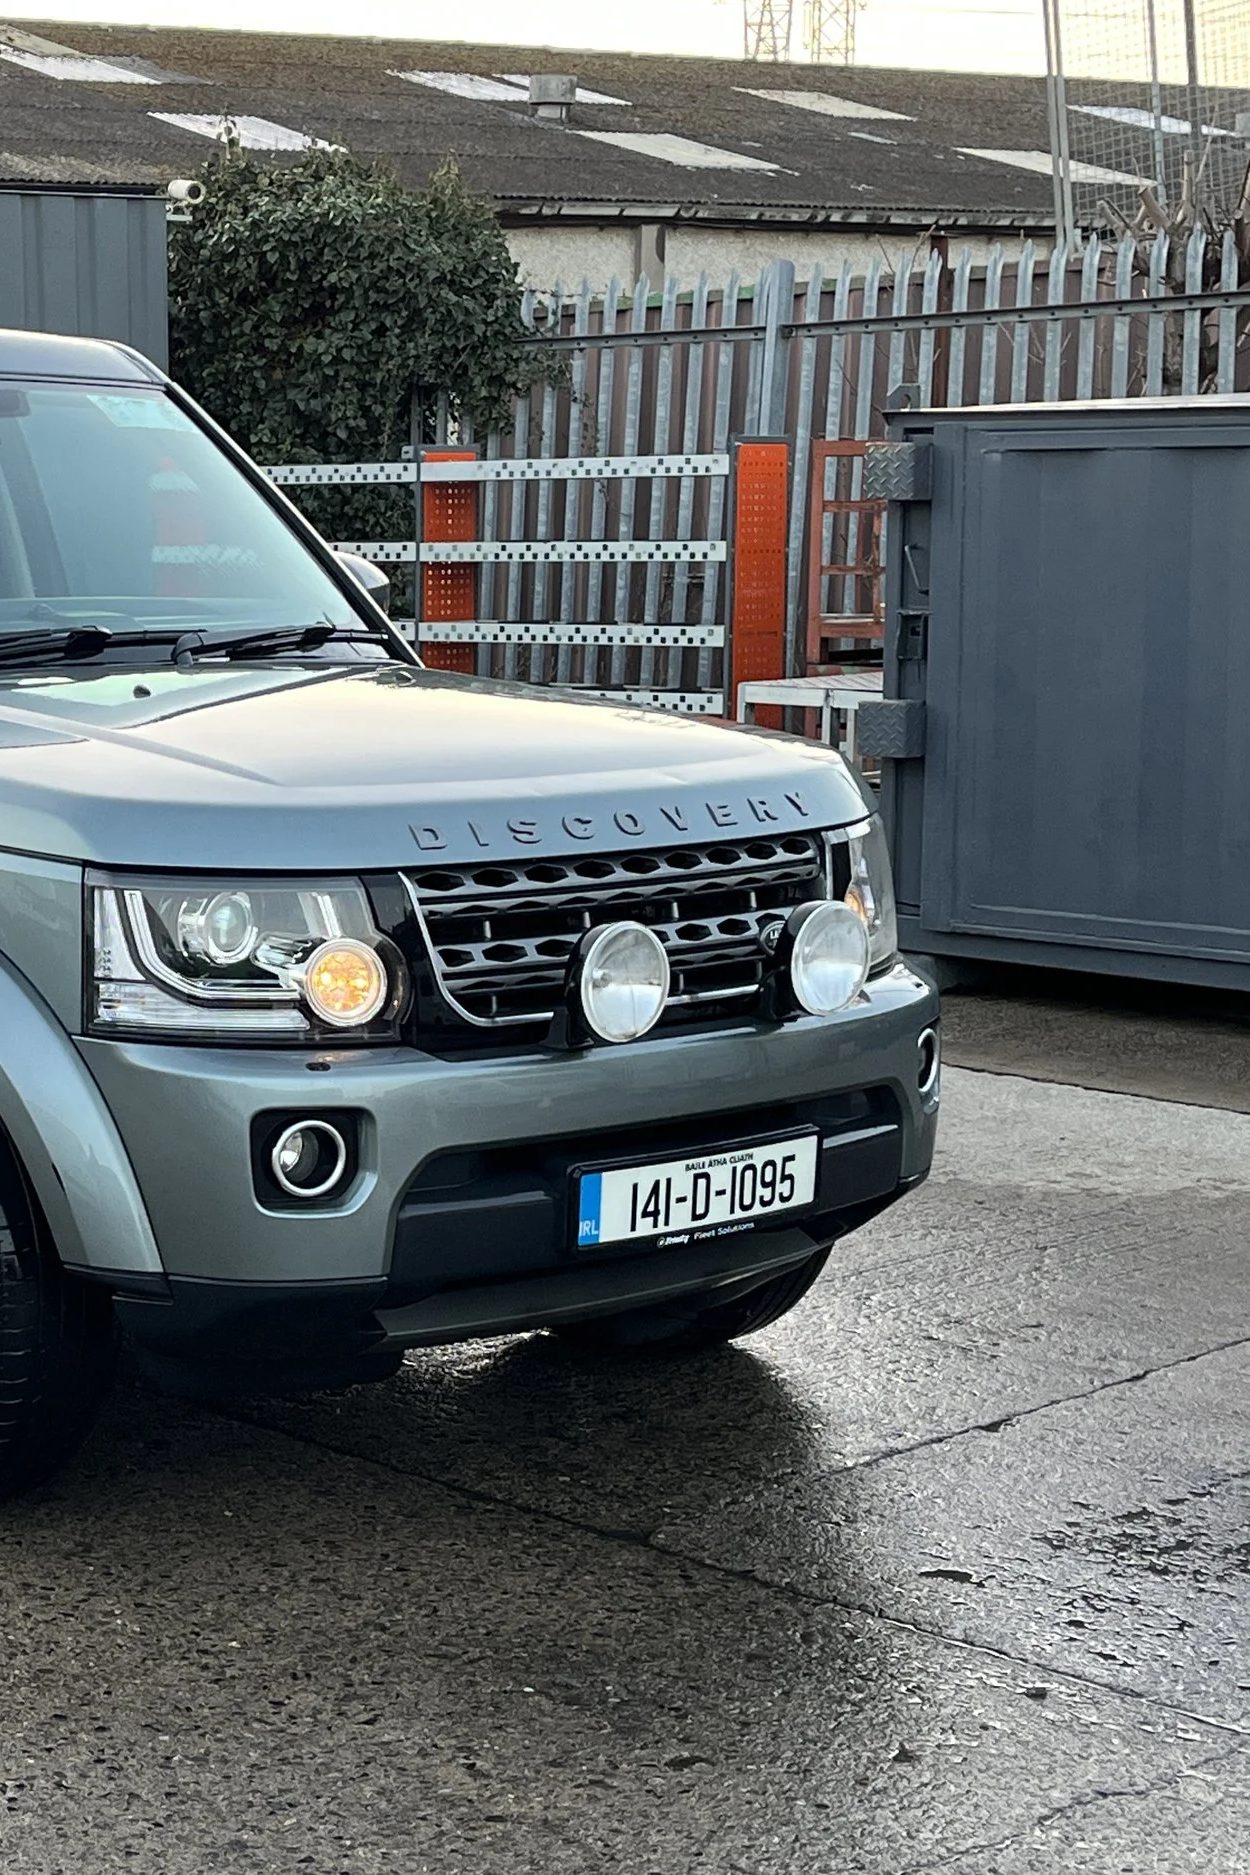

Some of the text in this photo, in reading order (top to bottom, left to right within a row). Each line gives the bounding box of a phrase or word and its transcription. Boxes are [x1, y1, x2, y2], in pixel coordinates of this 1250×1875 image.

[408, 791, 811, 850] DISCOVERY
[685, 1161, 706, 1172] BAILE
[729, 1152, 754, 1164] CLIATH
[630, 1154, 796, 1232] 141-D-1095
[579, 1220, 599, 1237] IRL
[694, 1229, 716, 1240] Fleet
[717, 1222, 755, 1236] Solutions
